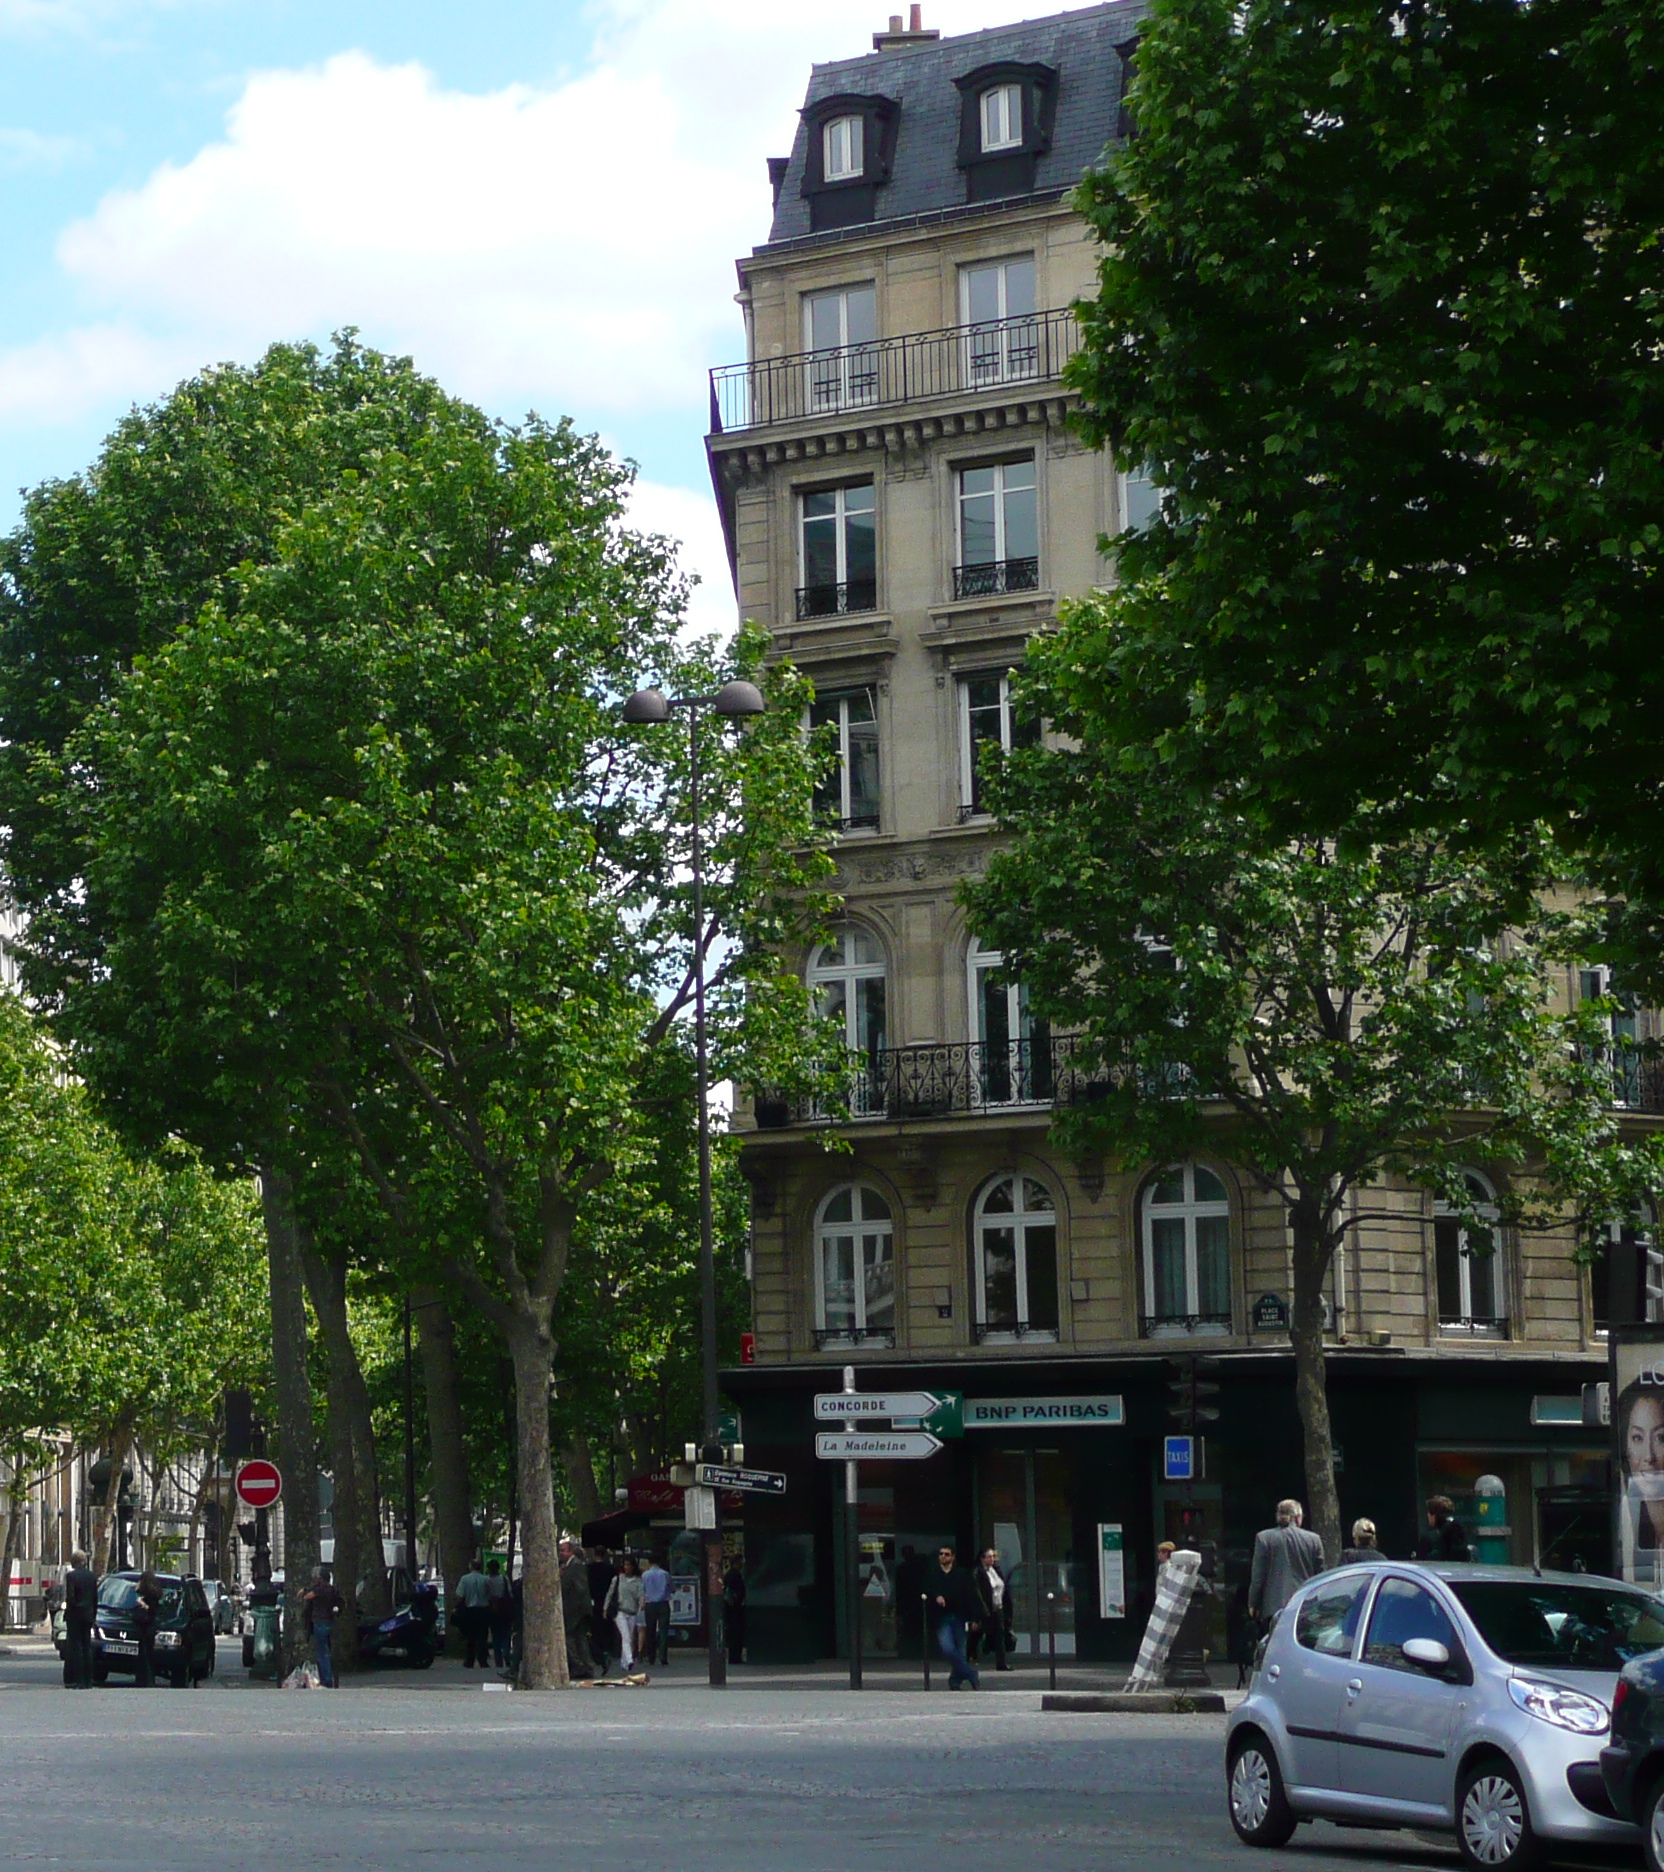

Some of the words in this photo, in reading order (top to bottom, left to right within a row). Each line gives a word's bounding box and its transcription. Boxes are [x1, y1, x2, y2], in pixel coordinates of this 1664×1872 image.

[821, 1400, 886, 1412] CONCORDE
[975, 1406, 1017, 1419] BNP
[1022, 1404, 1109, 1418] PARIBAS
[823, 1441, 837, 1451] La
[844, 1440, 907, 1451] Madeleine
